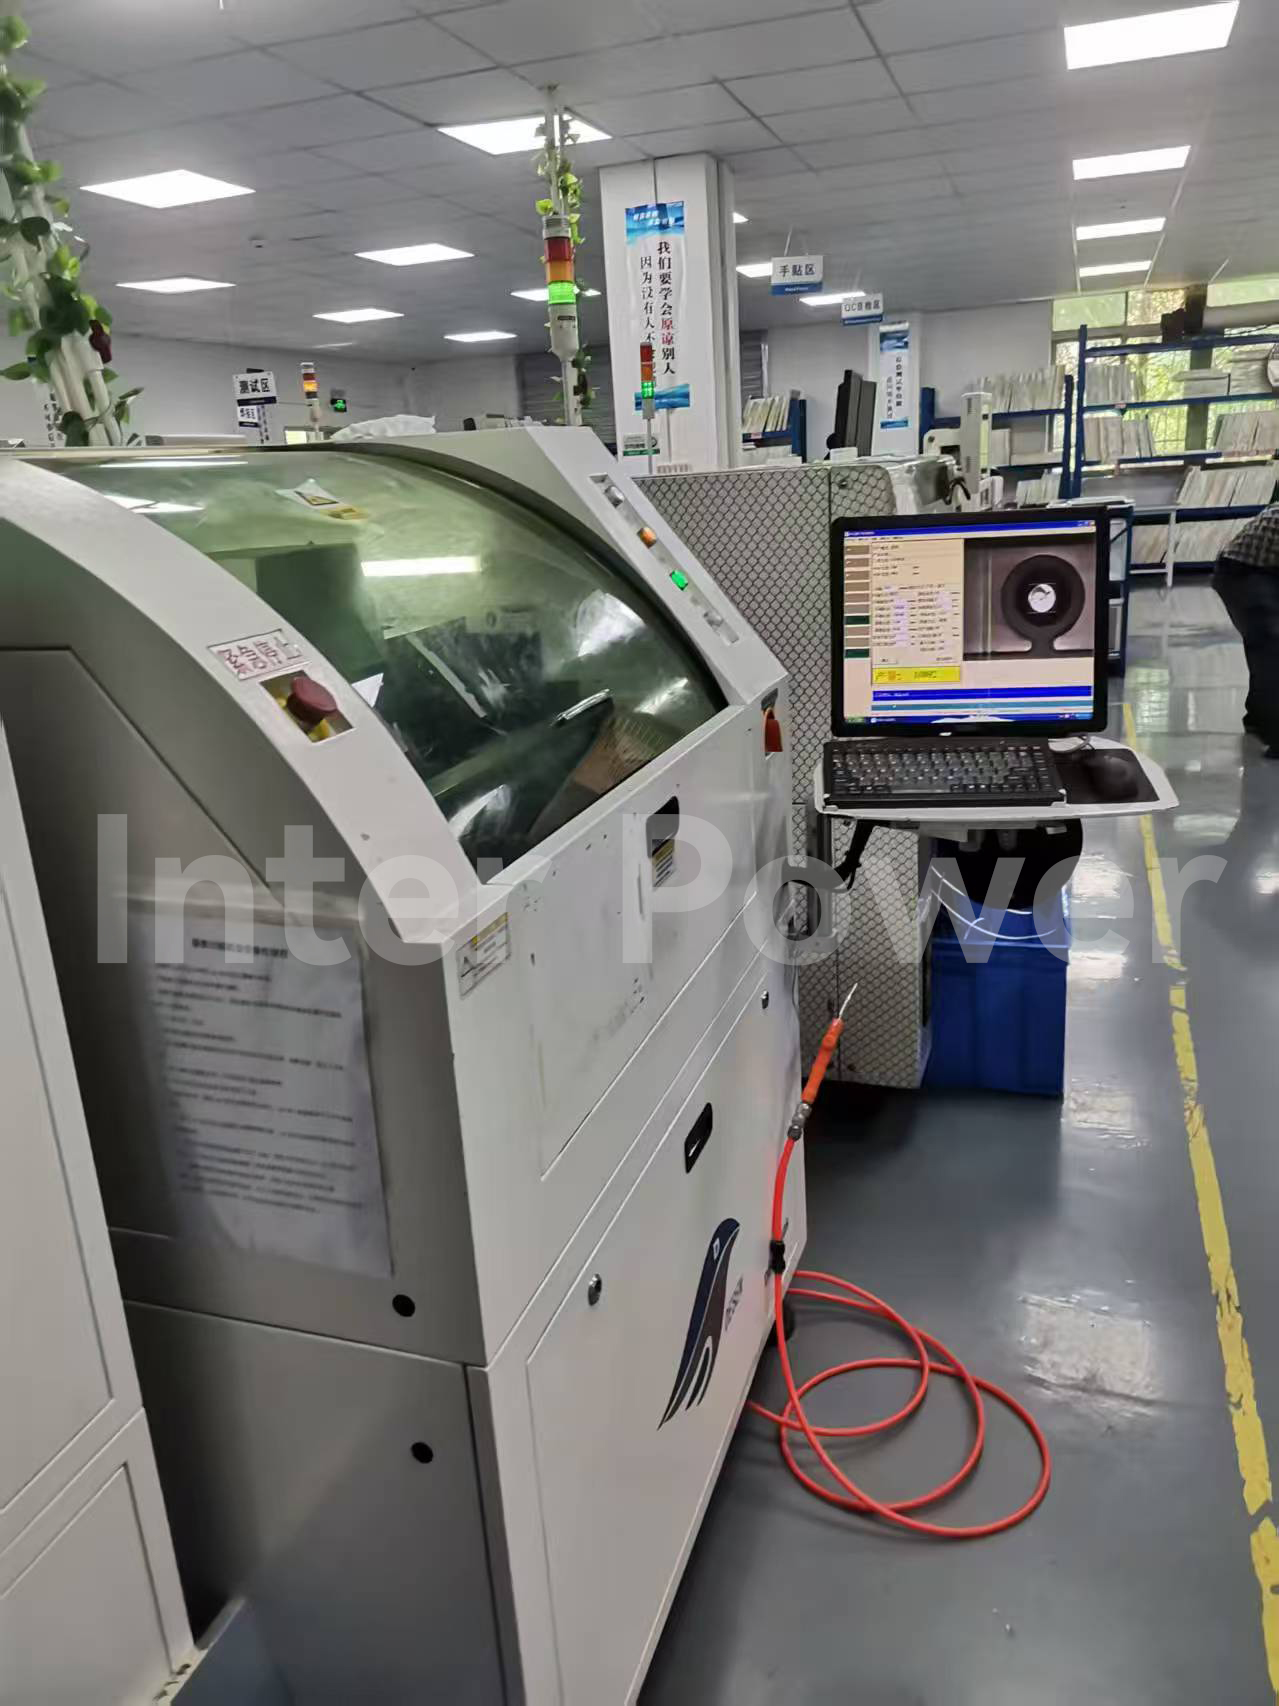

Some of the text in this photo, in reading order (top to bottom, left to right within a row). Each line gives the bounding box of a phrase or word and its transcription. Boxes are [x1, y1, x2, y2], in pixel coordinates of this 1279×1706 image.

[658, 241, 675, 375] 我们要学会原谅别人
